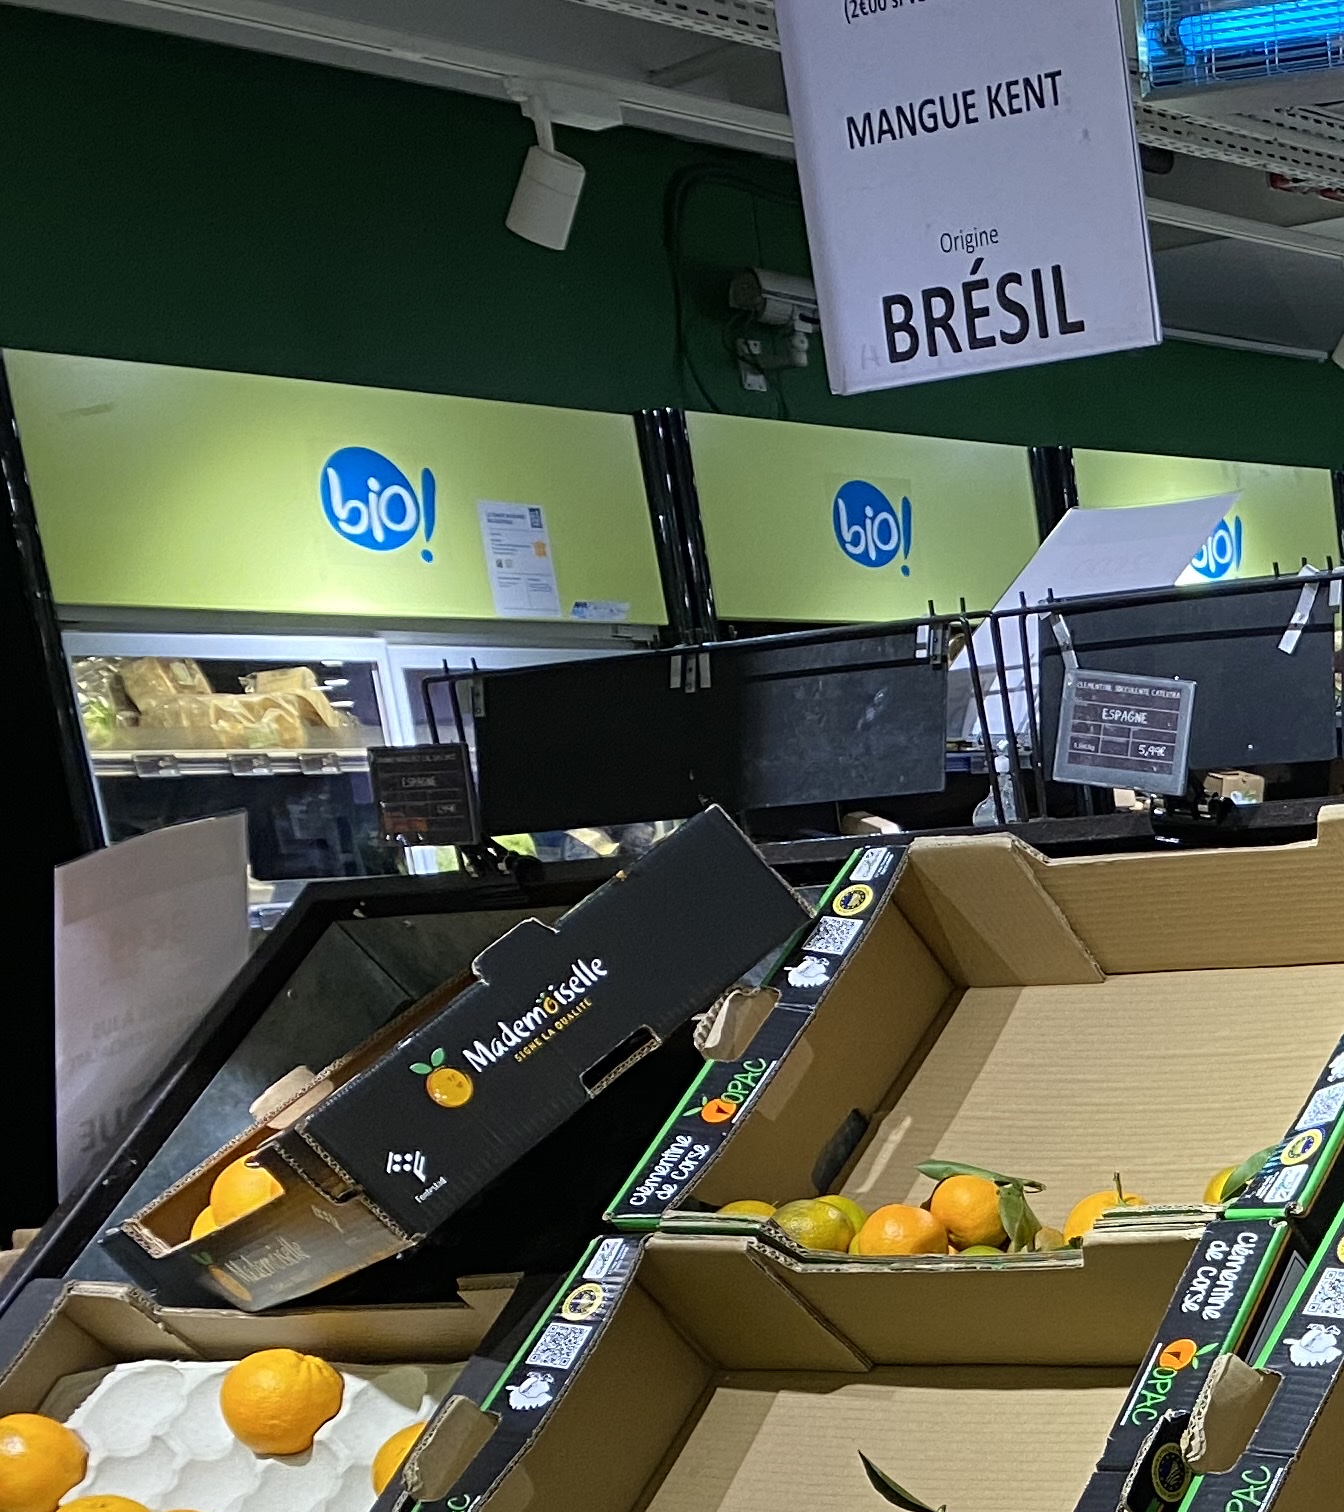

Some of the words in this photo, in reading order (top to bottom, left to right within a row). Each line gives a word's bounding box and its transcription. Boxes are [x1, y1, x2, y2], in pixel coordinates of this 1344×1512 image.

[846, 89, 979, 149] MANGUE
[987, 69, 1063, 118] KENT
[940, 226, 999, 253] Origine
[882, 258, 1085, 363] BRÉSIL
[1102, 708, 1148, 724] ESPAGNE
[462, 957, 608, 1073] Mademoiselle
[541, 1028, 556, 1041] LA
[720, 1057, 767, 1105] OPAC
[629, 1134, 691, 1206] Clémentine
[655, 1179, 677, 1201] de
[1202, 1232, 1258, 1321] Clémentine
[1205, 1240, 1231, 1262] de
[1130, 1366, 1178, 1426] OPAC
